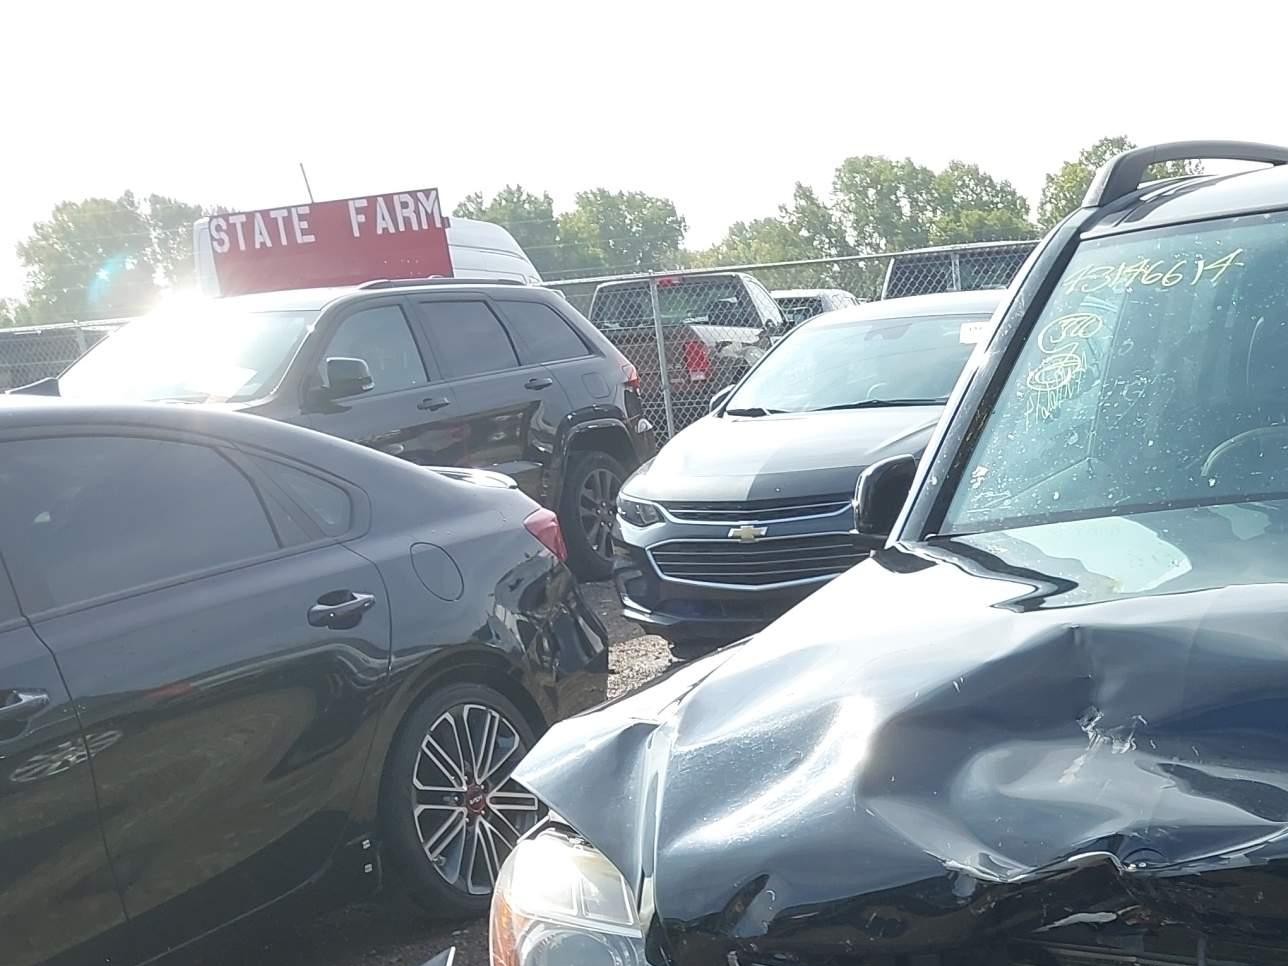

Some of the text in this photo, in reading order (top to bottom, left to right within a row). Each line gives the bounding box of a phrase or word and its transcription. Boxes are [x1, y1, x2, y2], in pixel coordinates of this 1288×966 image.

[209, 189, 443, 254] STATE FARM
[1061, 248, 1245, 296] 43146614
